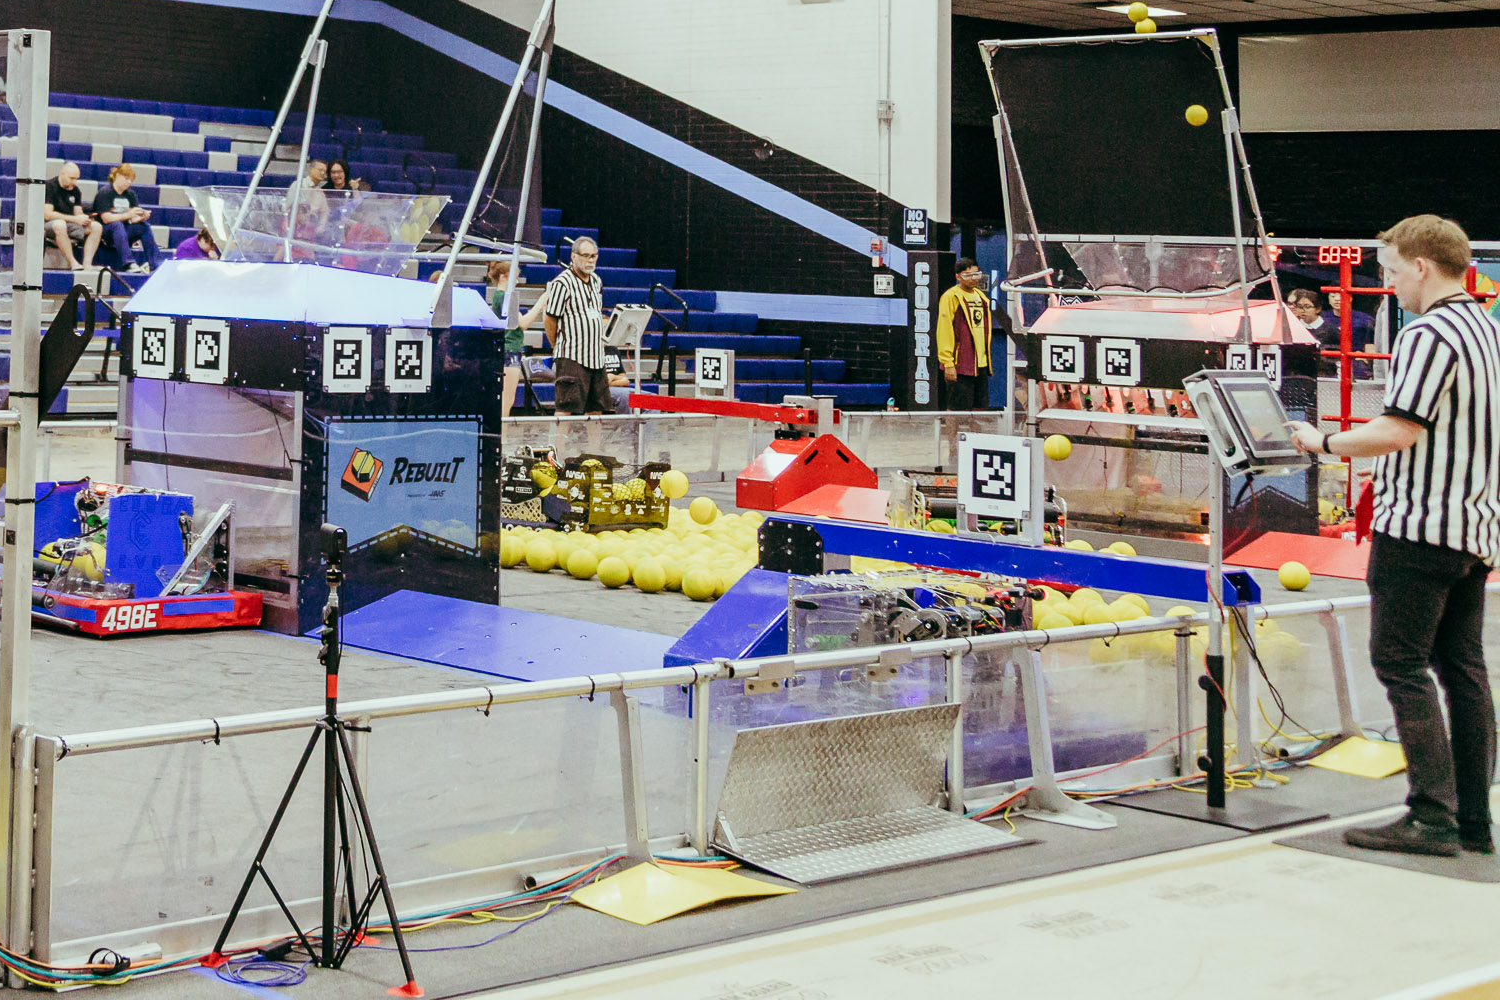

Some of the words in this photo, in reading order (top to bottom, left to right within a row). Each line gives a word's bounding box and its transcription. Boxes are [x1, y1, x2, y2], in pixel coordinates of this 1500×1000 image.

[908, 210, 923, 221] NO
[914, 262, 931, 404] COBRAS
[566, 470, 586, 480] NASA
[102, 603, 160, 632] 498E
